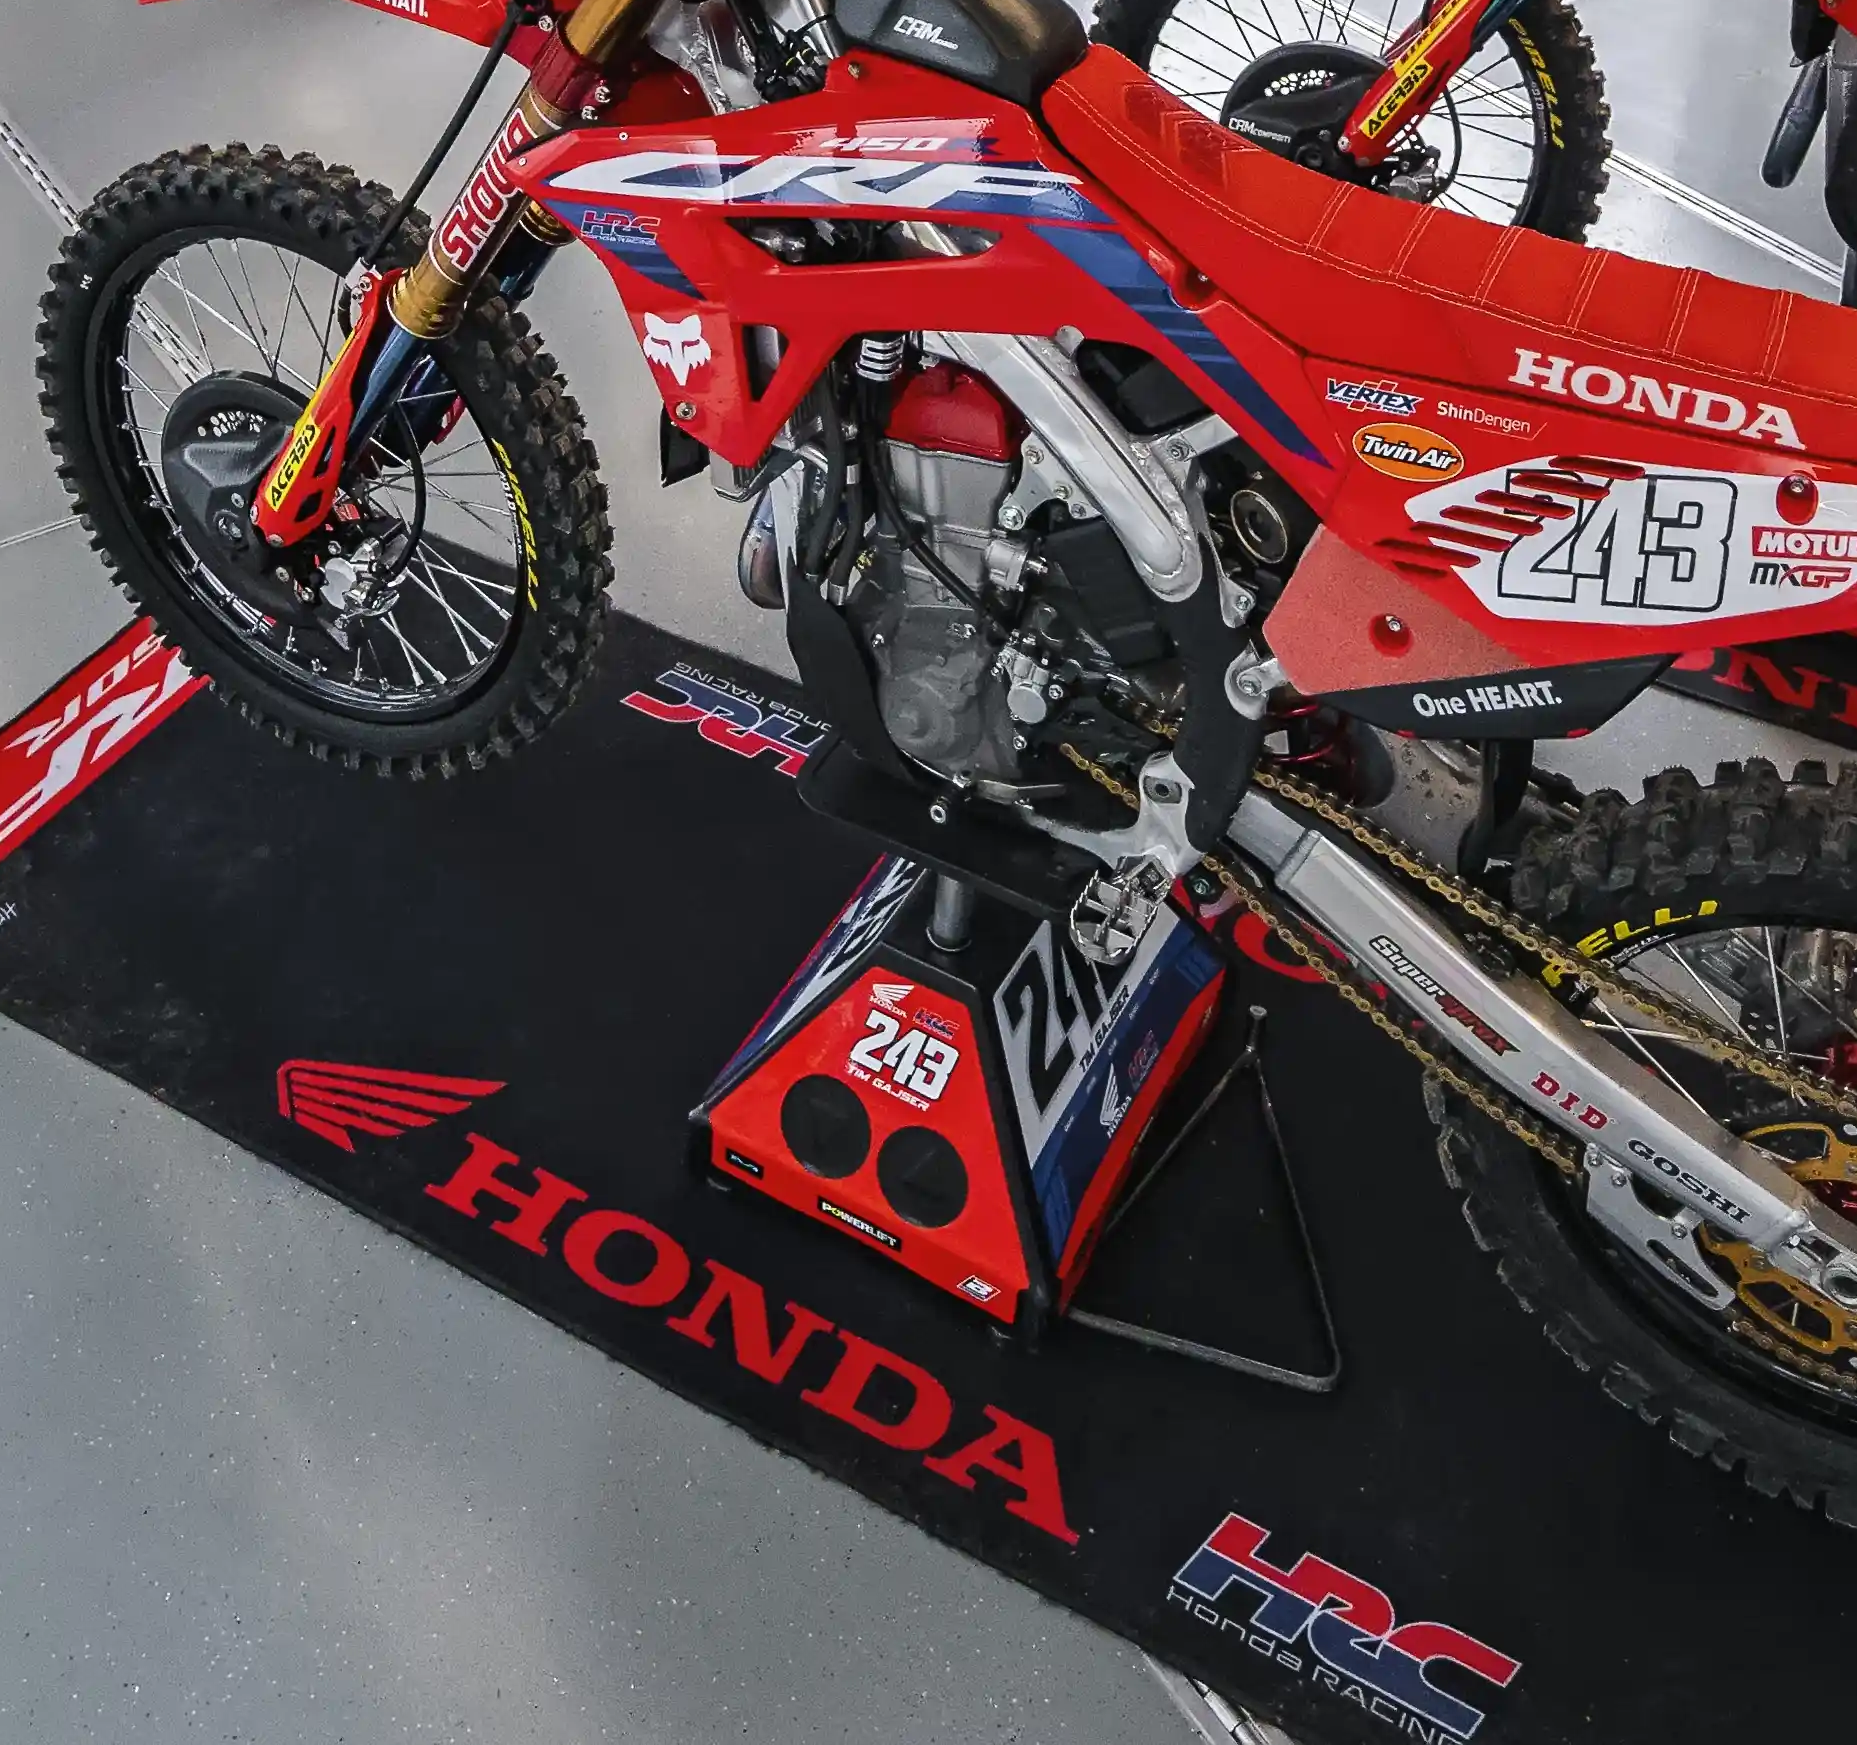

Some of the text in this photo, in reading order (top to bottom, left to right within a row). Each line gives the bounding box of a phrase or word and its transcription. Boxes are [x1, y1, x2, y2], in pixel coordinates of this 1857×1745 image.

[1366, 61, 1432, 137] ACERBIS
[1509, 18, 1564, 149] PIRELLI
[1228, 118, 1255, 135] CRM
[548, 151, 1084, 207] CRF
[581, 210, 661, 240] HRC
[1326, 378, 1424, 412] VERTEX
[1437, 401, 1531, 433] ShinDengen
[1508, 347, 1806, 451] HONDA
[269, 425, 320, 508] ACERBIS
[1363, 435, 1457, 470] Twin Air
[491, 437, 539, 611] PIRELLI
[1498, 469, 1738, 613] 243
[1750, 562, 1852, 589] MXGP
[3, 634, 167, 758] 50R
[674, 662, 764, 705] RACING
[1412, 681, 1564, 721] One HEART.
[620, 670, 825, 777] HRC
[1369, 935, 1445, 997] Super
[869, 995, 907, 1018] HONDA
[847, 1064, 930, 1111] TIM GAJSER
[850, 1009, 959, 1100] 243
[1078, 1051, 1096, 1073] TIM
[1628, 1139, 1750, 1224] GOSHI
[822, 1201, 896, 1246] POWERLIFT
[424, 1134, 1080, 1545] HONDA
[1166, 1585, 1301, 1672] Honda
[1173, 1512, 1522, 1739] HRC
